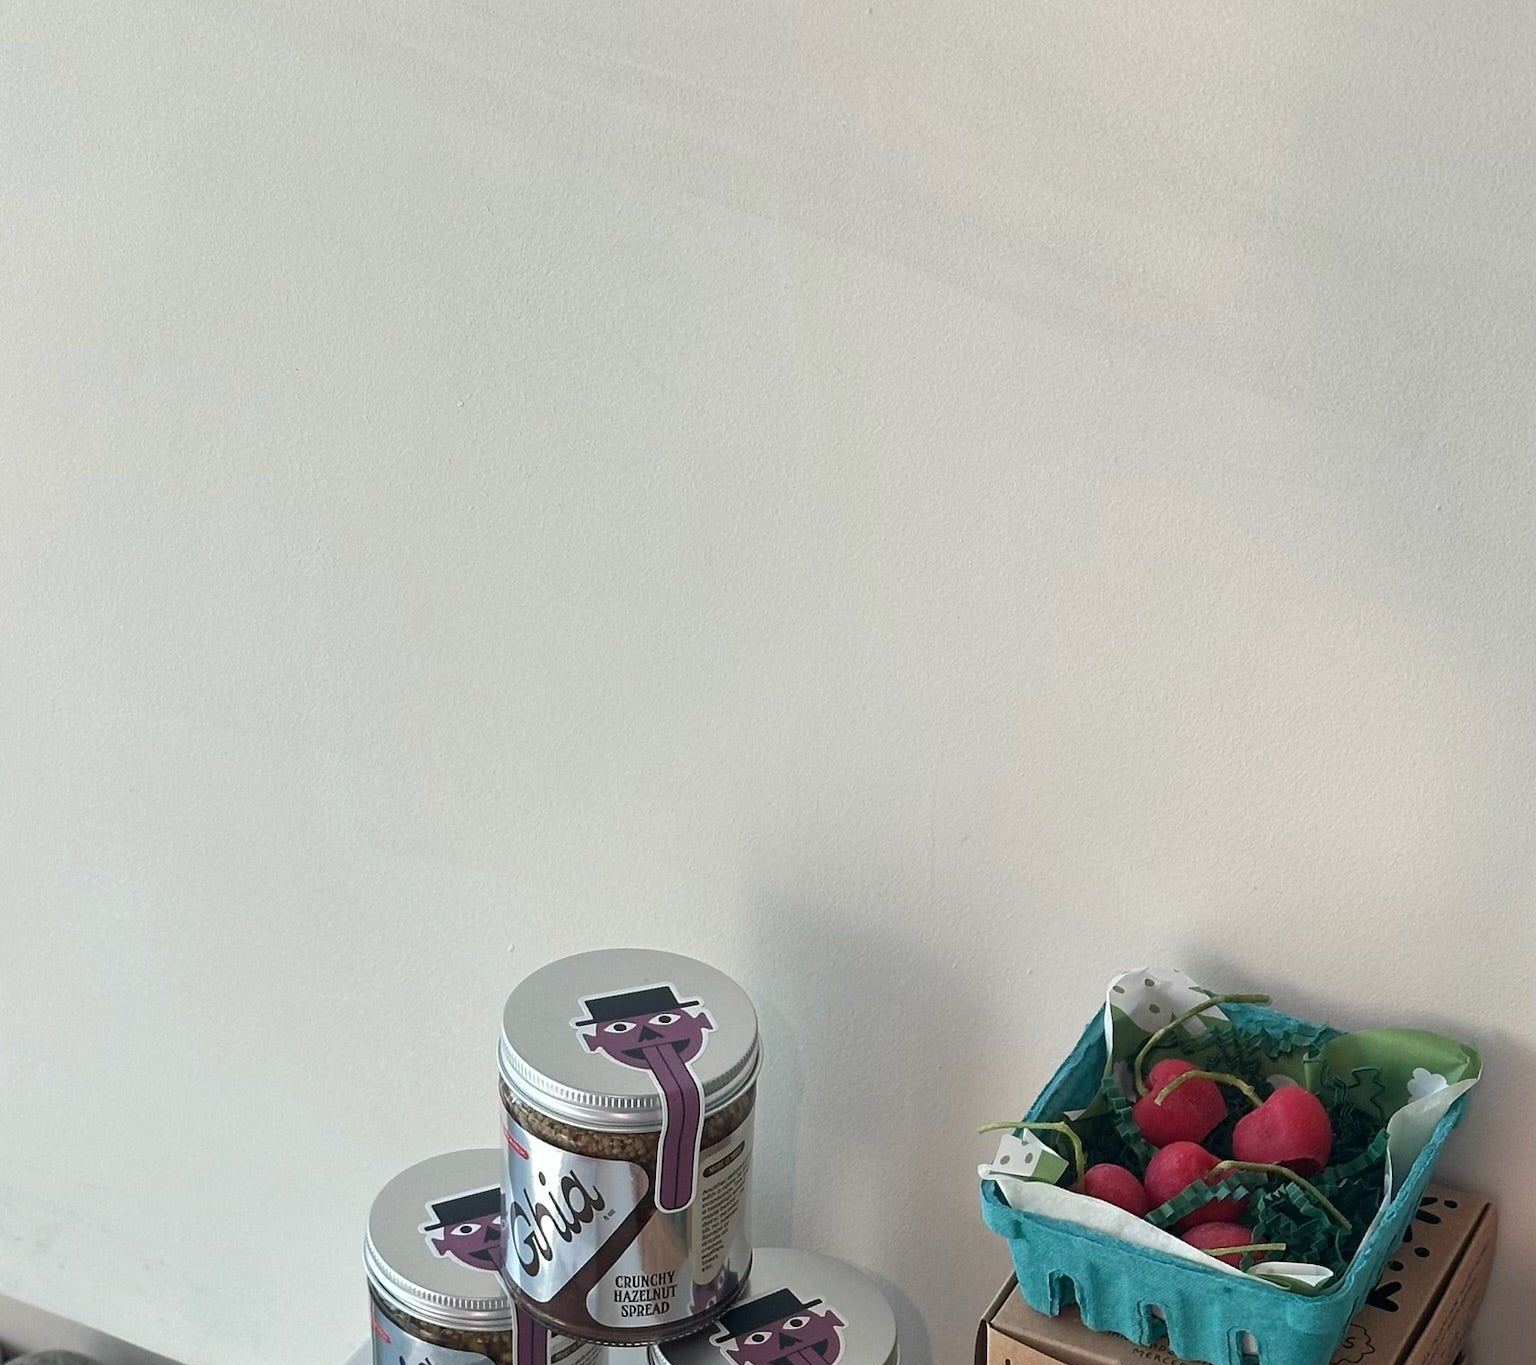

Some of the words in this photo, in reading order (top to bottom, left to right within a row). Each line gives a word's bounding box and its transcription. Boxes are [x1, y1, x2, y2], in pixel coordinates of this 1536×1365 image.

[510, 1169, 605, 1277] Ghia
[615, 1270, 676, 1289] CRUNCHY
[613, 1284, 678, 1303] HAZELNUT
[621, 1301, 670, 1318] SPREAD
